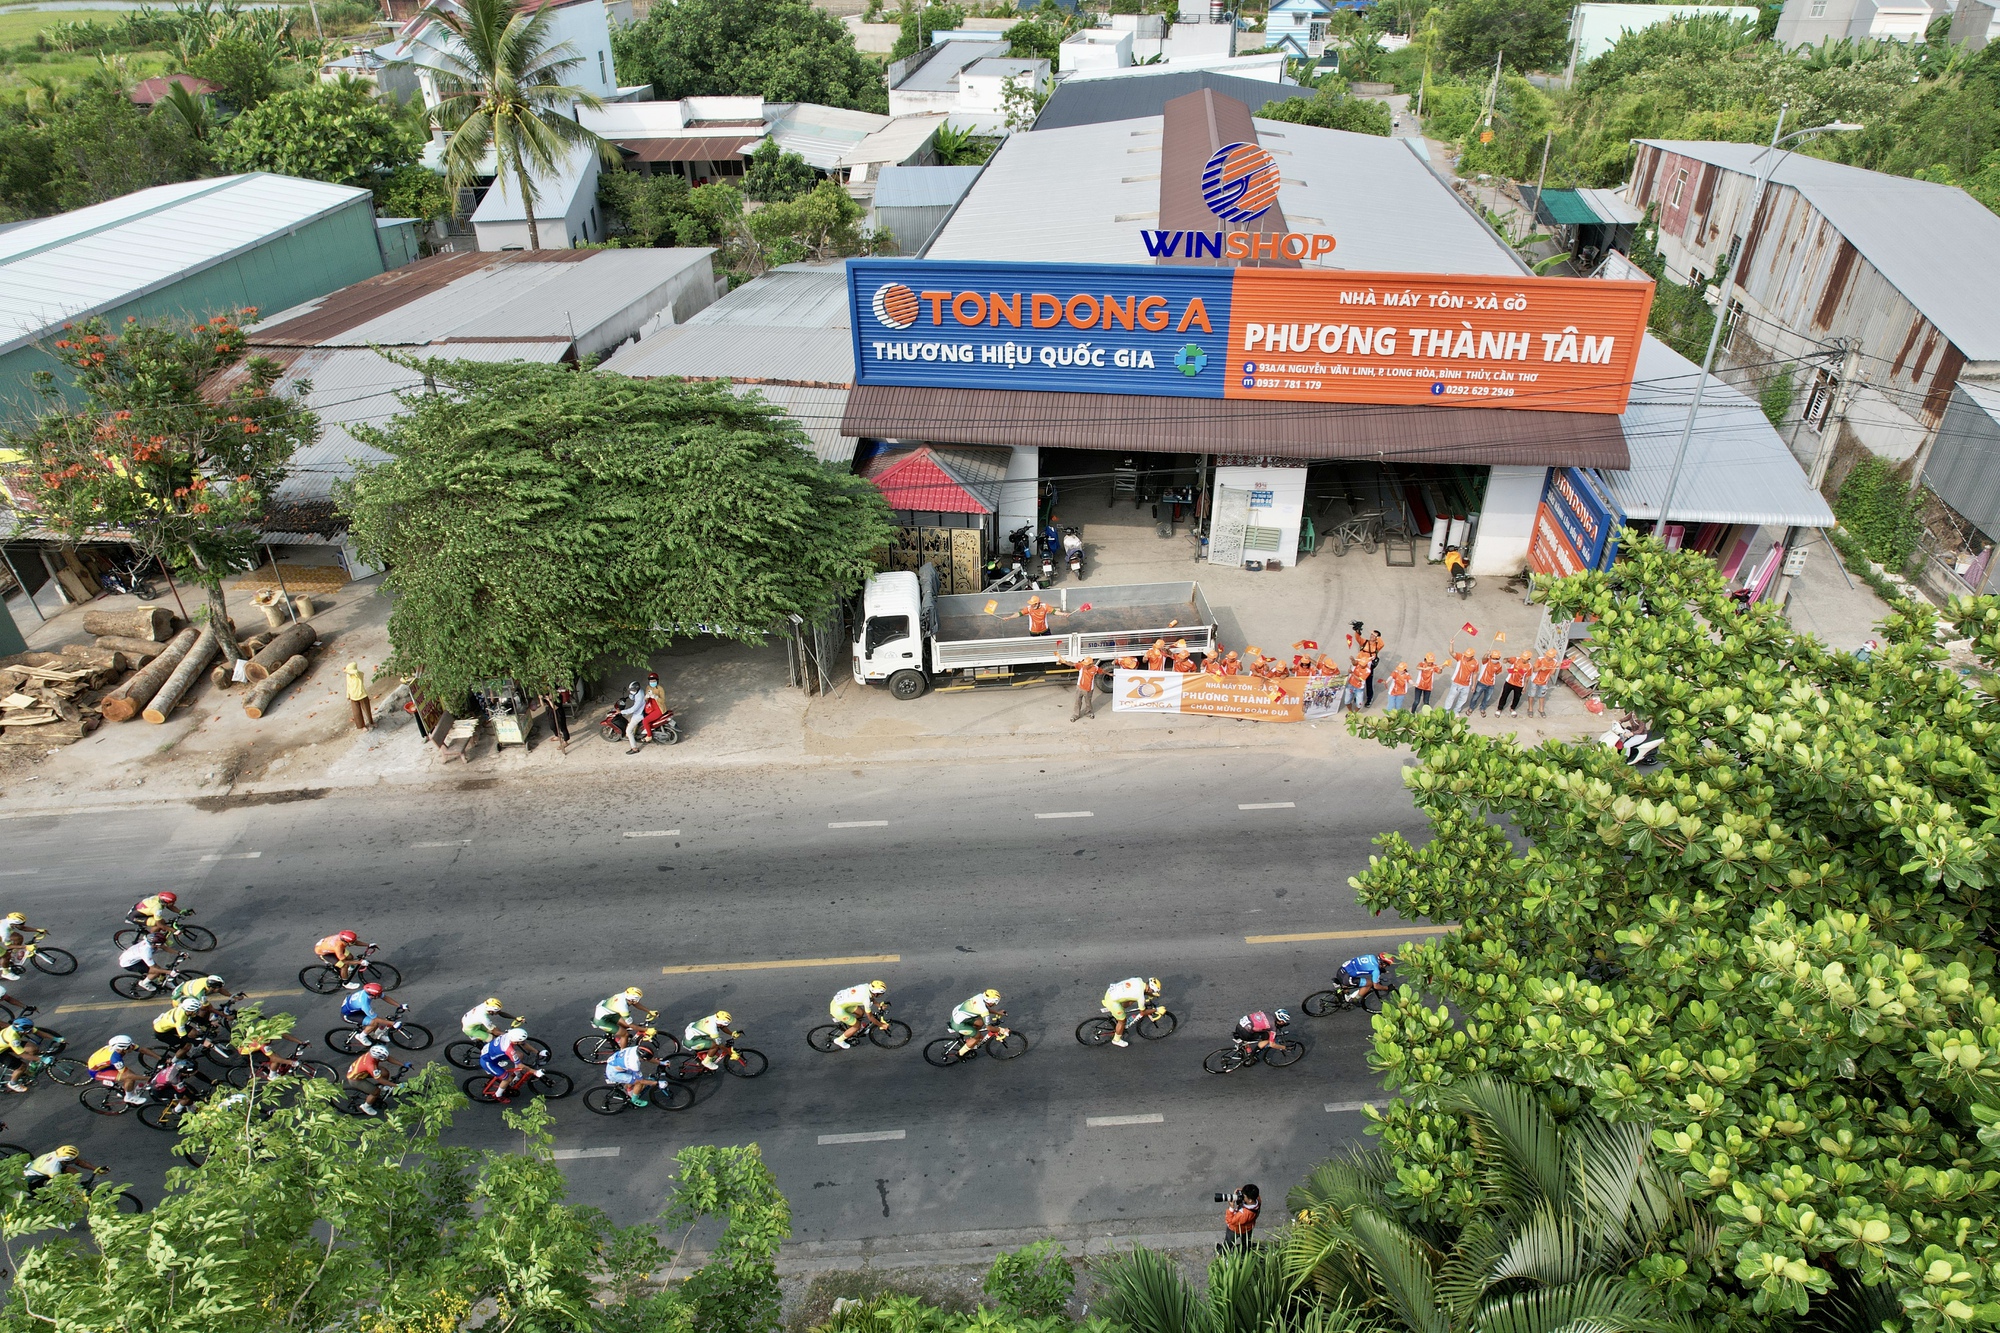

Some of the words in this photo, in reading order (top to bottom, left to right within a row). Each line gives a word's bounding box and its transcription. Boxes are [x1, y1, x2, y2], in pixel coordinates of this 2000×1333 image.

[1140, 229, 1337, 261] WINSHOP
[1339, 288, 1377, 306] NHÀ
[1383, 289, 1422, 307] MÁY
[1503, 292, 1527, 311] GỒ
[921, 290, 1022, 328] TON
[1031, 293, 1169, 332] DONG
[1176, 297, 1213, 333] A
[1244, 322, 1397, 355] PHƯƠNG
[1408, 321, 1530, 361] THÀNH
[1541, 325, 1615, 365] TÂM
[872, 340, 974, 364] THƯƠNG
[981, 341, 1032, 370] HIỆU
[1040, 342, 1105, 369] QUỐC
[1114, 349, 1155, 369] GIA
[1258, 363, 1286, 373] 93A/4
[1288, 361, 1327, 374] NGUYỄN
[1330, 363, 1350, 375] VĂN
[1352, 367, 1376, 378] LINH,
[1386, 367, 1413, 377] LONG
[1493, 368, 1515, 381] CẦN
[1518, 372, 1539, 382] THƠ
[1256, 379, 1280, 388] 0937
[1284, 379, 1301, 389] 781
[1305, 380, 1322, 390] 179
[1446, 385, 1469, 395] 0292
[1472, 386, 1489, 395] 629
[1491, 387, 1515, 396] 2949
[1126, 675, 1165, 699] 25
[1222, 682, 1237, 690] MÁY
[1237, 683, 1253, 691] TÔN
[1182, 691, 1229, 702] PHƯƠNG
[1233, 694, 1271, 705] THÀNH
[1190, 703, 1214, 711] CHÀO
[1216, 704, 1242, 713] MỪNG
[1244, 707, 1269, 715] ĐOÀN
